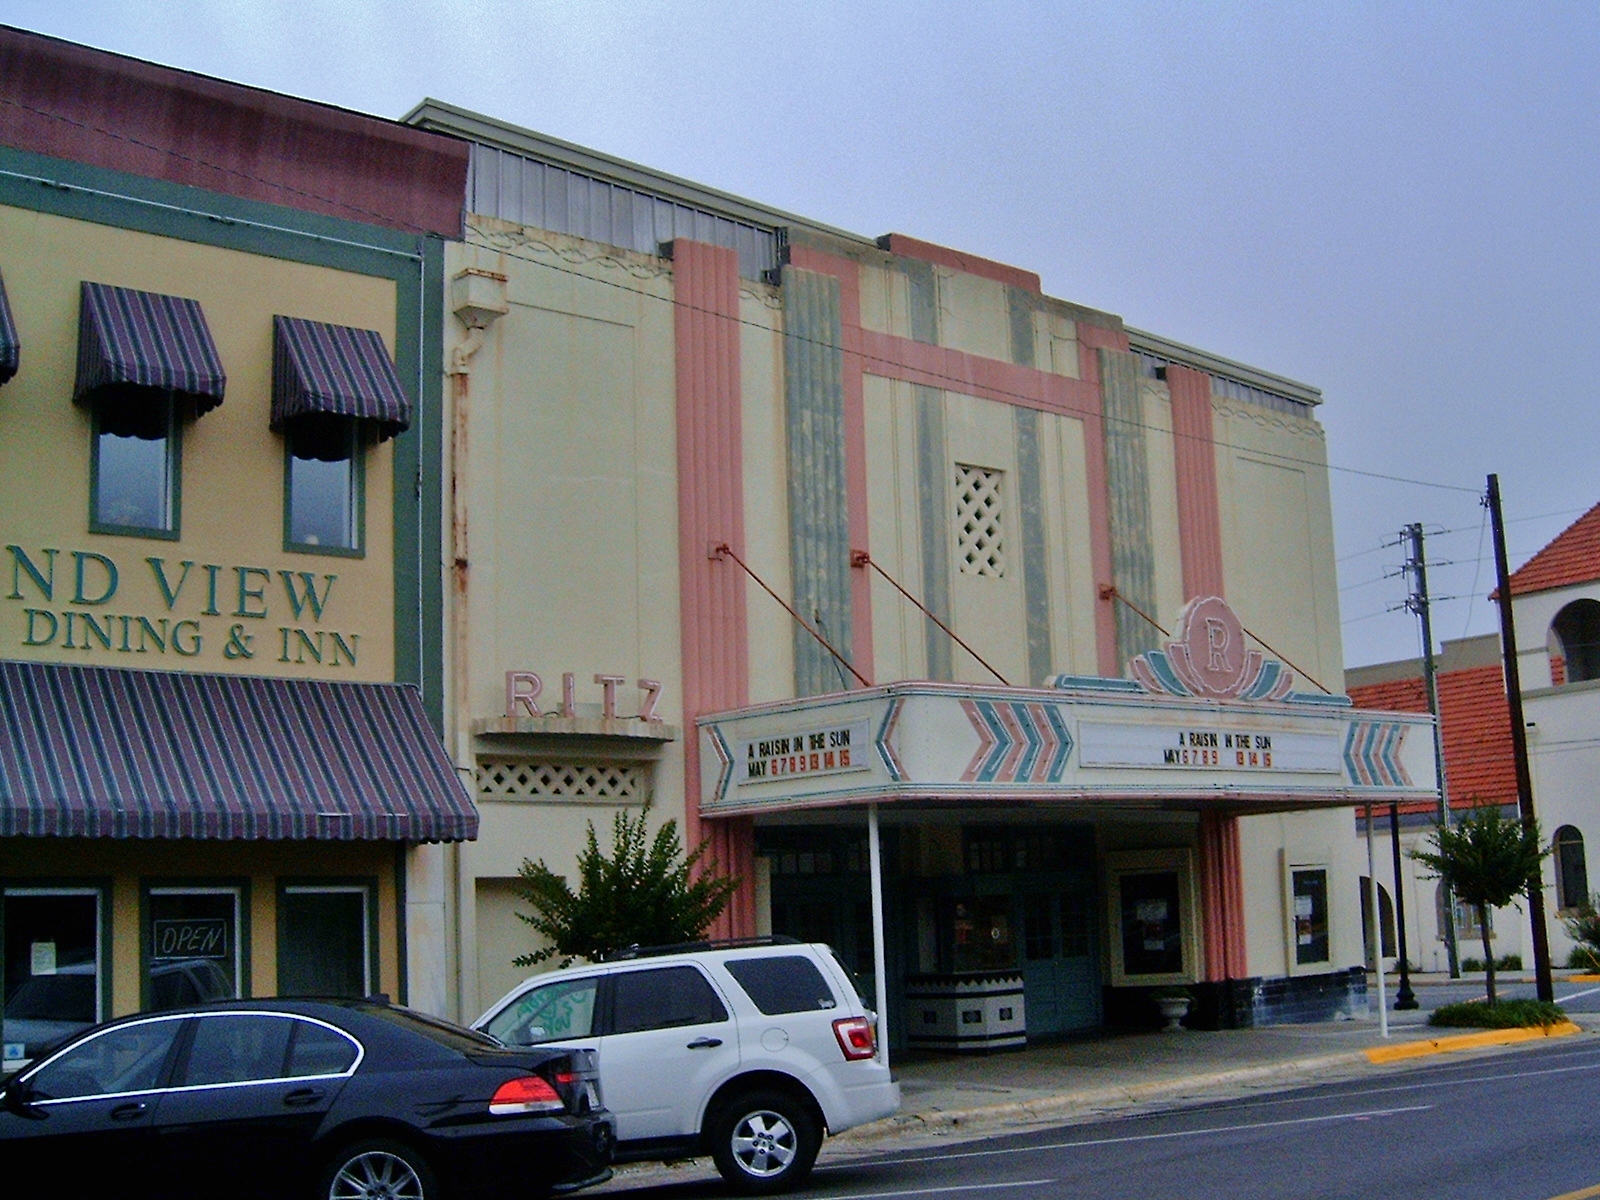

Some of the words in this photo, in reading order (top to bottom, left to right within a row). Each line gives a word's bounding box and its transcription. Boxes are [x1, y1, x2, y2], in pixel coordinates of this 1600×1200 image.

[6, 544, 119, 606] ND
[146, 557, 339, 623] VIEW
[22, 608, 204, 656] DINING
[223, 623, 255, 659] &
[278, 627, 361, 666] INN
[1205, 617, 1233, 672] R
[505, 670, 664, 723] RITZ
[748, 743, 755, 759] A
[759, 738, 790, 758] RAISIN
[794, 736, 803, 752] IN
[809, 732, 825, 751] THE
[830, 729, 850, 748] SUN
[1179, 732, 1185, 747] A
[1189, 732, 1218, 748] RAISIN
[1225, 733, 1232, 748] IN
[1235, 734, 1250, 749] THE
[1255, 735, 1271, 750] SUN
[748, 760, 767, 778] MAY
[781, 757, 787, 774] 7
[800, 755, 806, 772] 9
[1164, 749, 1180, 764] MAY
[1182, 749, 1189, 765] 6
[1192, 750, 1198, 765] 7
[1212, 750, 1218, 765] 9
[1248, 751, 1258, 767] 14
[1263, 752, 1271, 767] 15
[162, 925, 223, 954] OPEN
